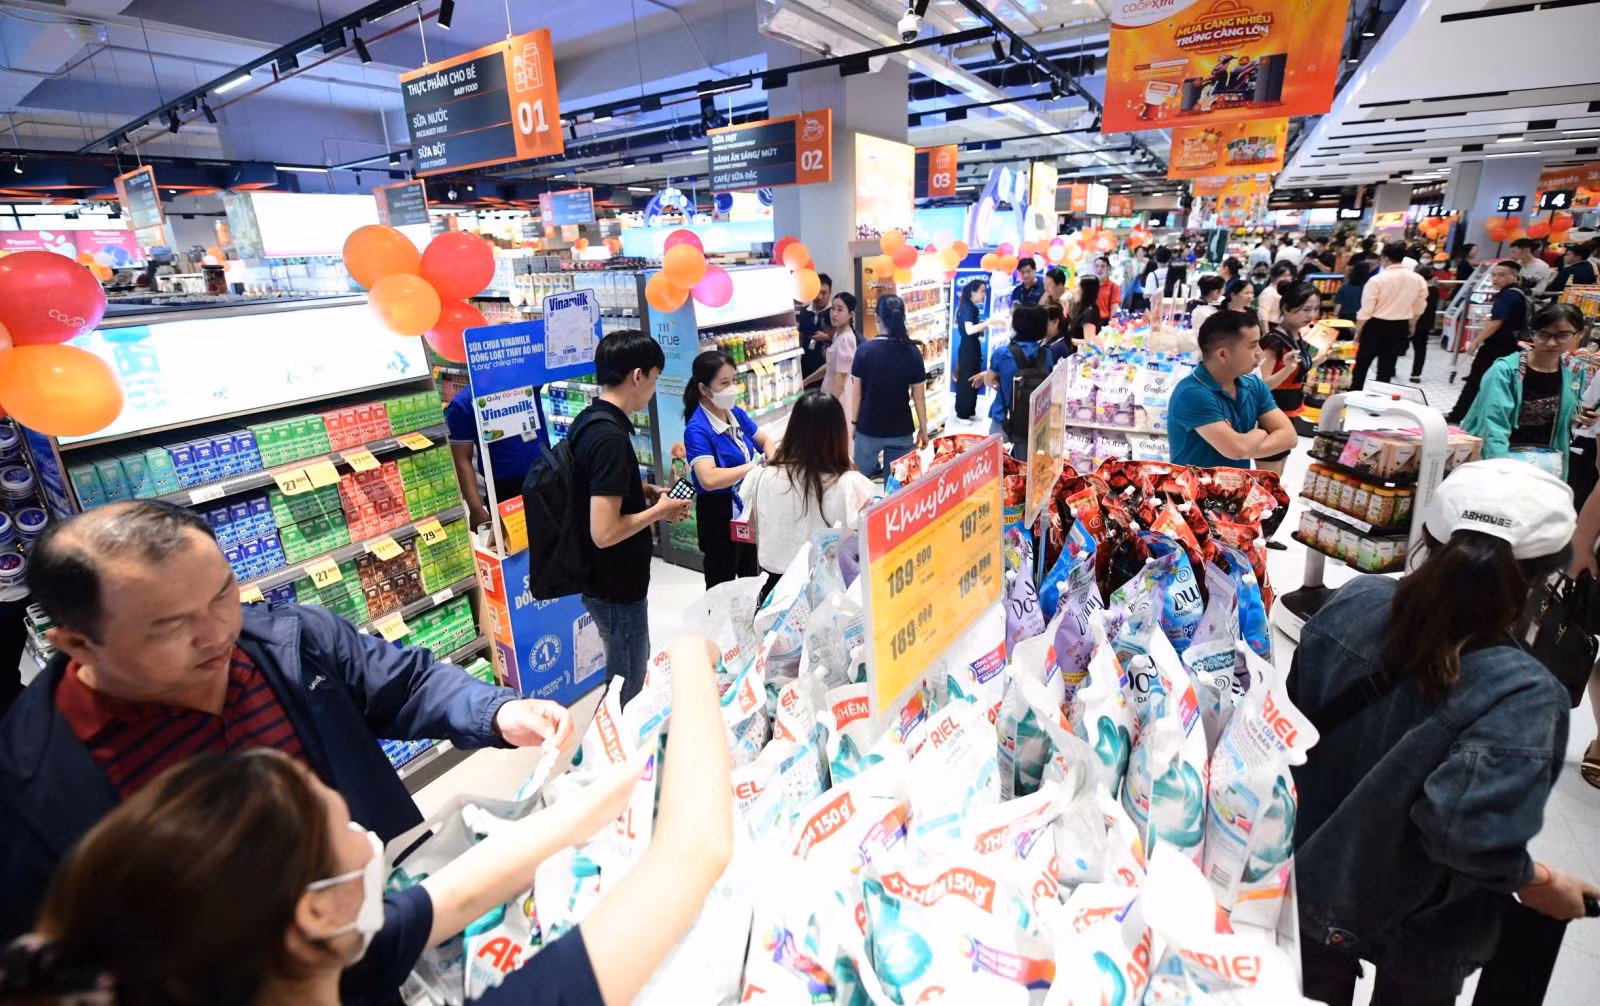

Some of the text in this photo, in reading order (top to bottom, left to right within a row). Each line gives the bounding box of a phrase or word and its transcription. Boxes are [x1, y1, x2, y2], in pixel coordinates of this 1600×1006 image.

[1177, 13, 1271, 37] MUA CÀNG NHIỀU
[1176, 32, 1211, 47] TRÚNG
[1213, 26, 1244, 39] CÀNG
[1245, 24, 1269, 35] LỚN
[408, 64, 477, 96] THỰC PHẨM CHO BÉ
[465, 83, 478, 93] FOOD
[413, 108, 448, 128] SỮA NƯỚC
[517, 99, 550, 136] 01
[418, 143, 446, 159] SỮA BỘT
[801, 149, 823, 171] 02
[933, 172, 950, 188] 03
[1507, 198, 1520, 210] 5
[1551, 193, 1565, 207] 4
[549, 292, 588, 311] Vinamilk
[482, 339, 500, 350] CHUA
[500, 335, 531, 348] VINAMILK
[658, 334, 680, 346] true
[481, 400, 533, 421] Vinamilk
[283, 479, 297, 492] 27
[885, 451, 992, 541] Khuyến mãi
[423, 531, 436, 541] 29
[315, 571, 328, 582] 27
[1263, 695, 1298, 749] RIEL
[930, 716, 961, 749] RIEL
